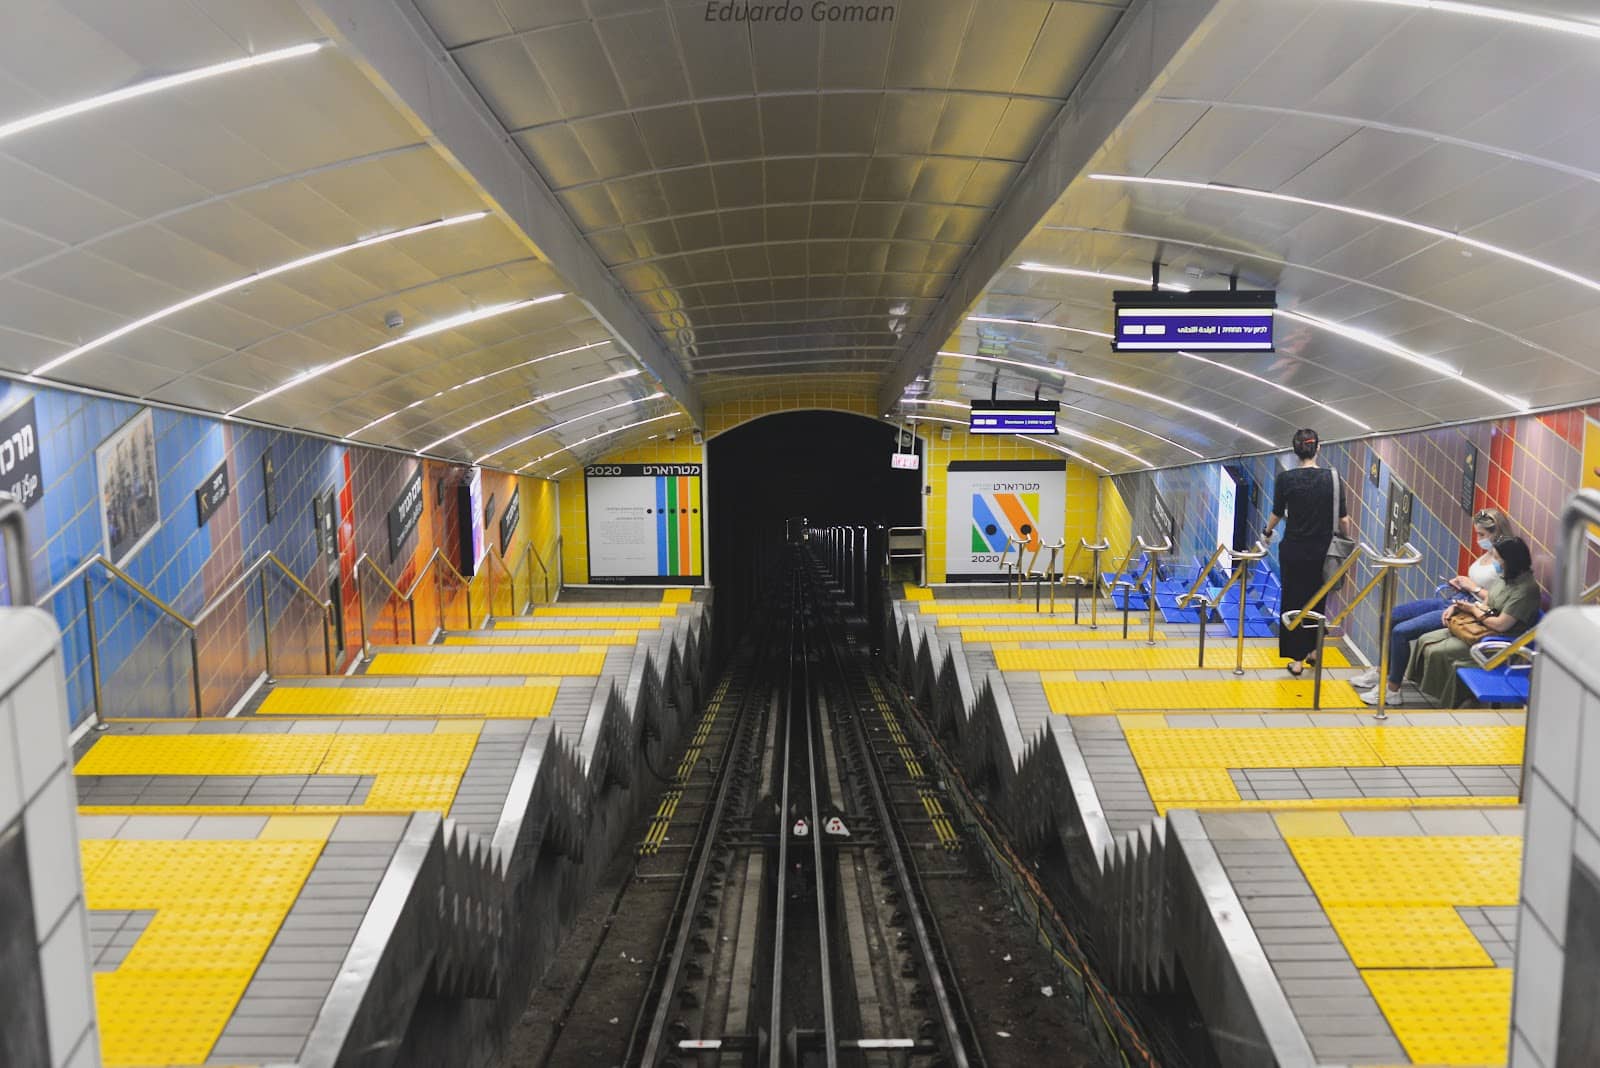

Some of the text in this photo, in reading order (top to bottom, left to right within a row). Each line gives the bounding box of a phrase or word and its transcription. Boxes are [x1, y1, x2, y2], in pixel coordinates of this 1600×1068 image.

[586, 466, 622, 476] 2020
[643, 465, 700, 475] מטרוארט
[993, 483, 1040, 491] מטרוארט
[971, 555, 1000, 563] 2020
